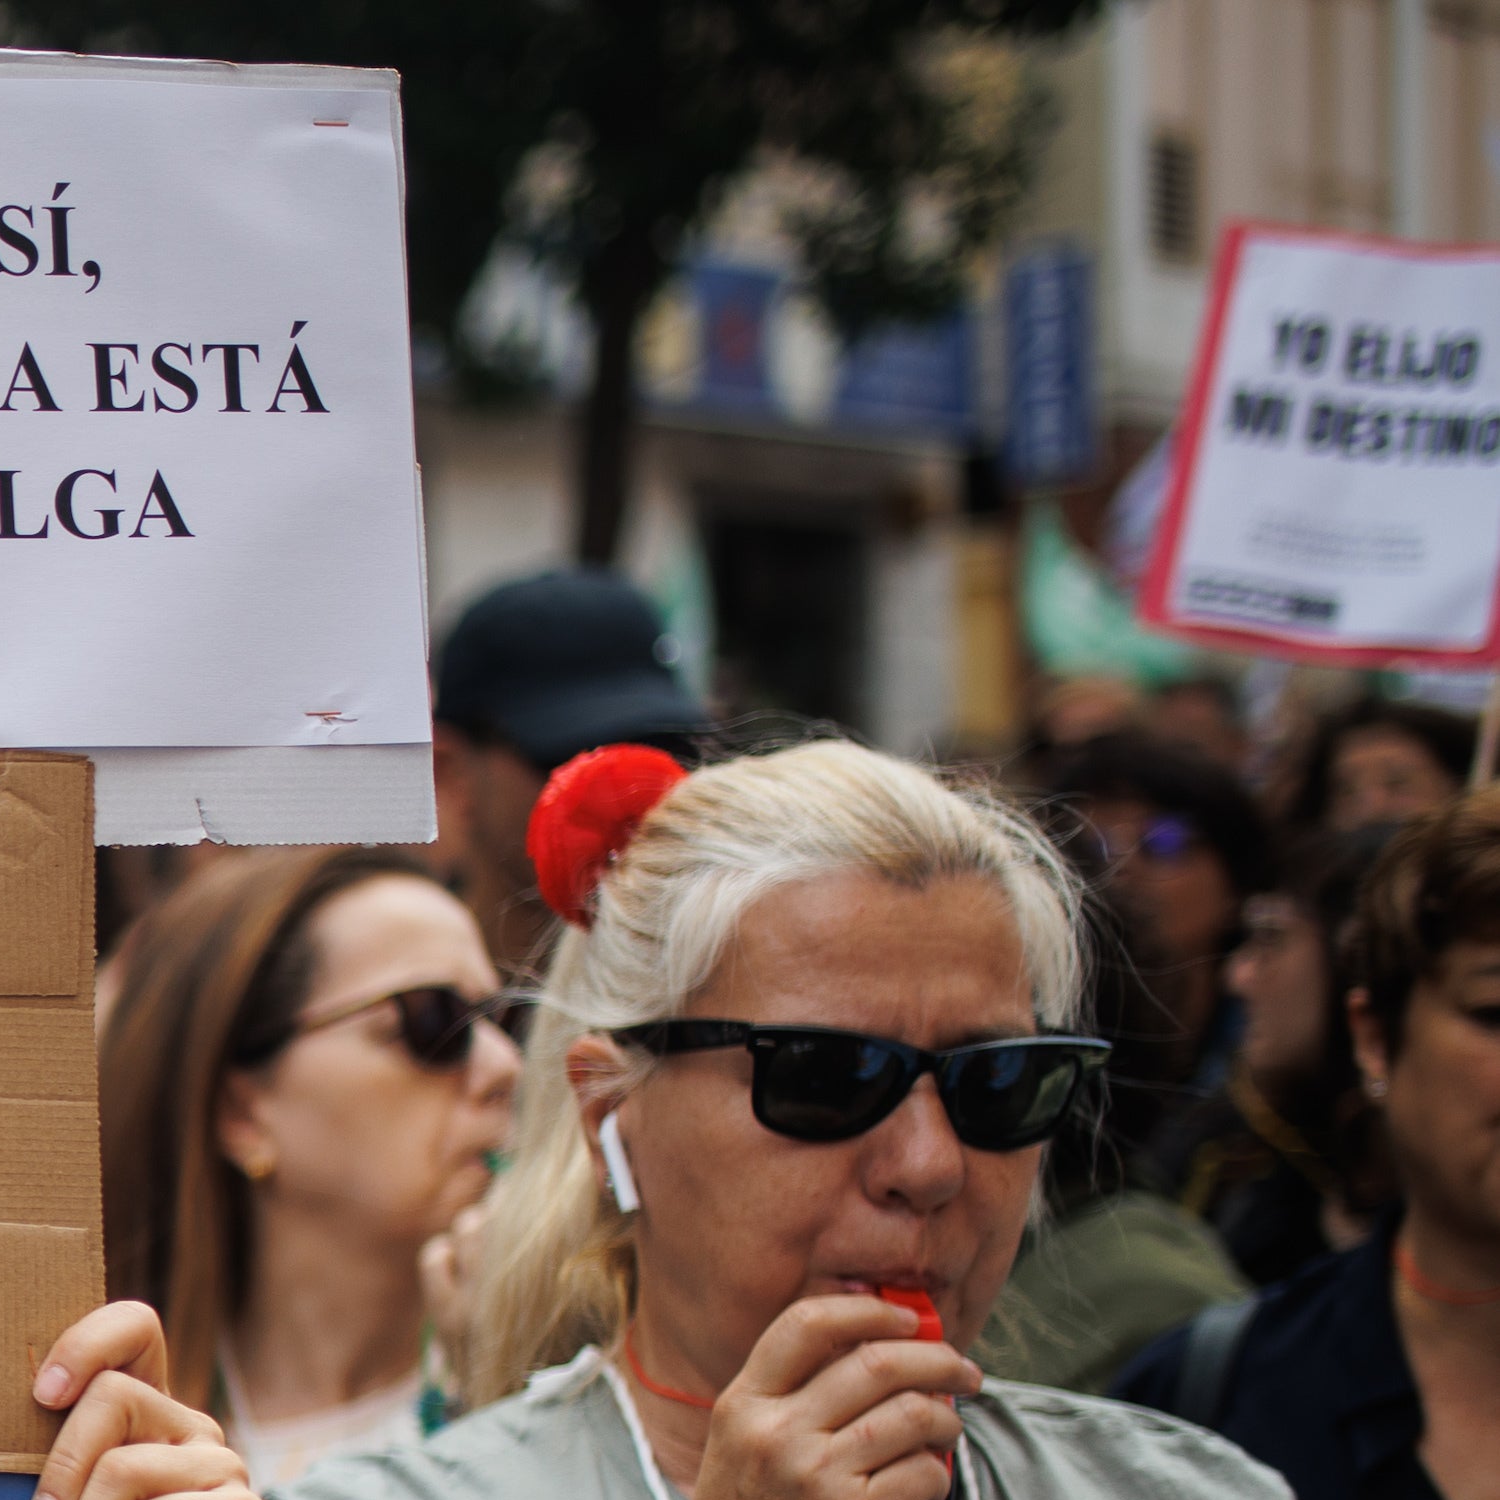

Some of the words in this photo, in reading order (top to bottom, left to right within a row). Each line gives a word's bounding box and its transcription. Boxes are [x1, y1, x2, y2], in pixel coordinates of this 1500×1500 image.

[85, 320, 331, 414] ESTÁ
[1273, 317, 1331, 372] YO
[1342, 326, 1483, 384] ELIJO
[1226, 386, 1291, 439] MI
